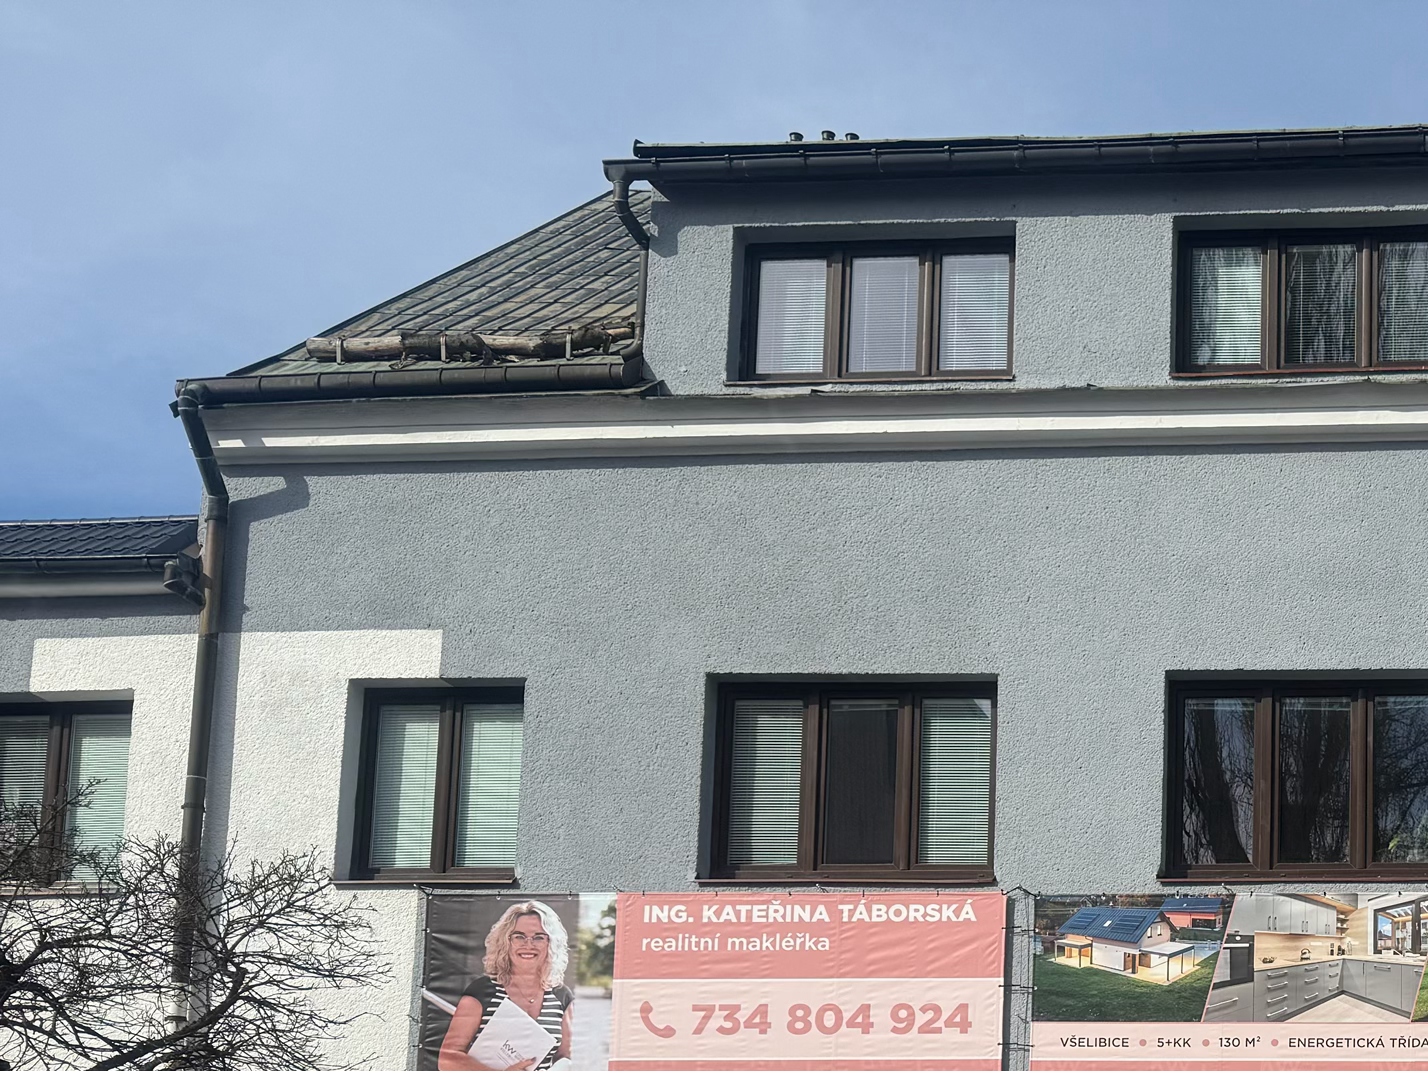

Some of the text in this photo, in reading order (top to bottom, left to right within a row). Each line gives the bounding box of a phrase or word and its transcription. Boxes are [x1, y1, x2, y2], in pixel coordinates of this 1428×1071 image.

[643, 899, 977, 923] ING. KATEŘINA TÁBORSKÁ
[642, 932, 830, 951] realitní makléřka
[691, 1002, 973, 1036] 734 804 924
[1060, 1034, 1130, 1048] VŠELIBICE
[1156, 1037, 1192, 1048] 5+KK
[1218, 1037, 1241, 1048] 130
[1288, 1035, 1385, 1048] ENERGETICKÁ
